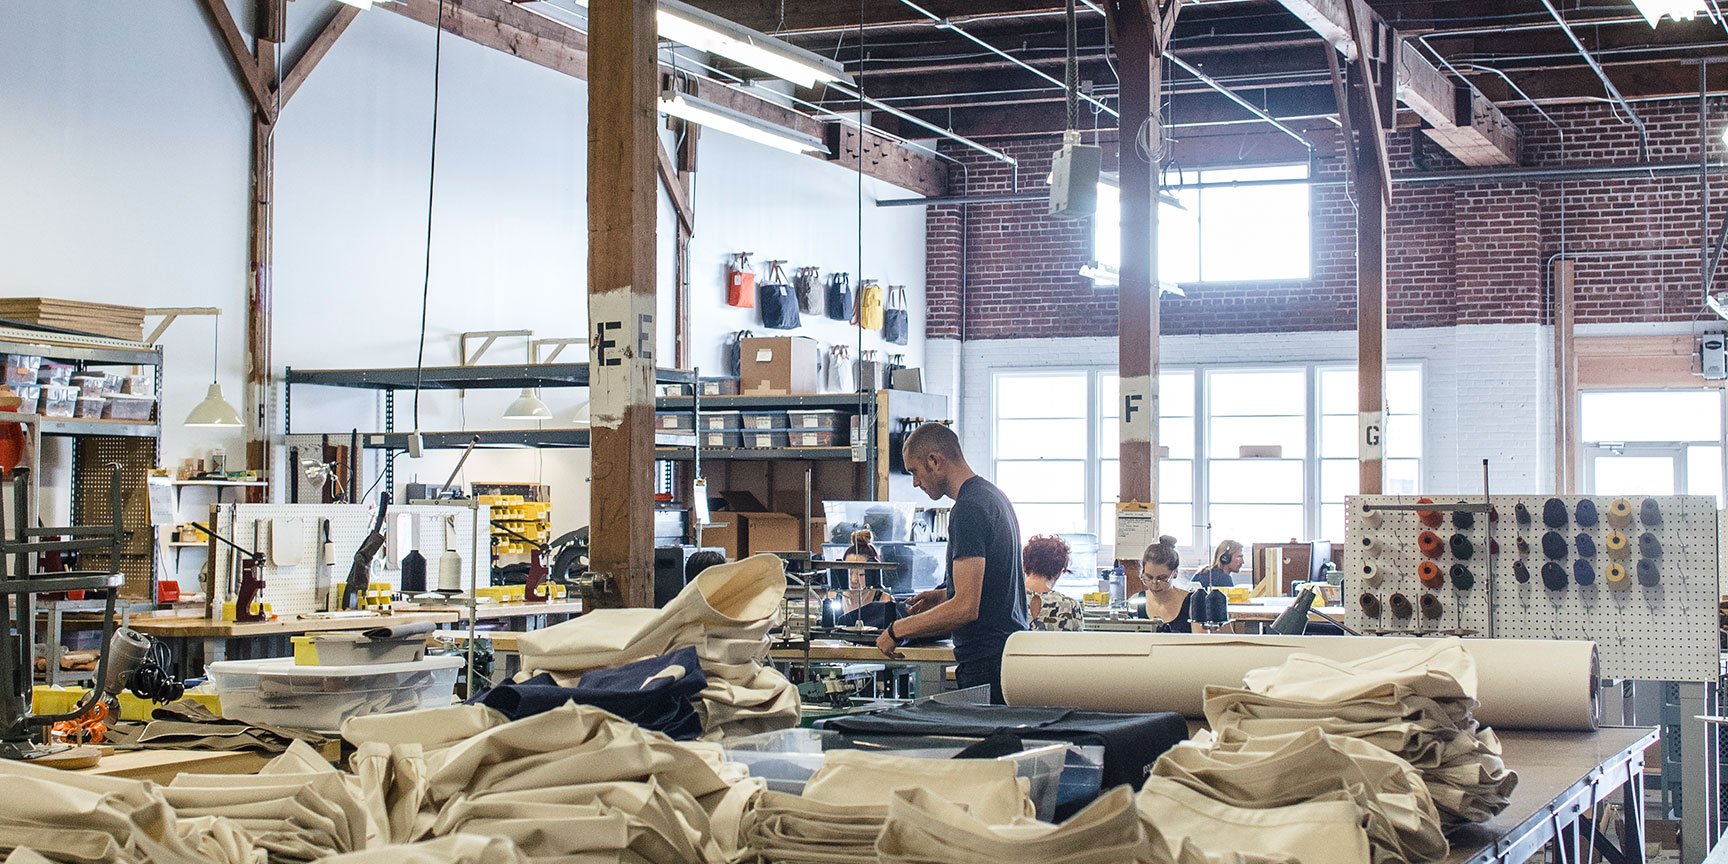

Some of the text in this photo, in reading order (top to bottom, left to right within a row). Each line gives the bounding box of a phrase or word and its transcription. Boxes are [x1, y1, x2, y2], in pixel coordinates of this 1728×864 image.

[597, 321, 621, 367] E
[638, 313, 652, 359] E
[1125, 394, 1142, 423] F
[1366, 425, 1379, 446] G
